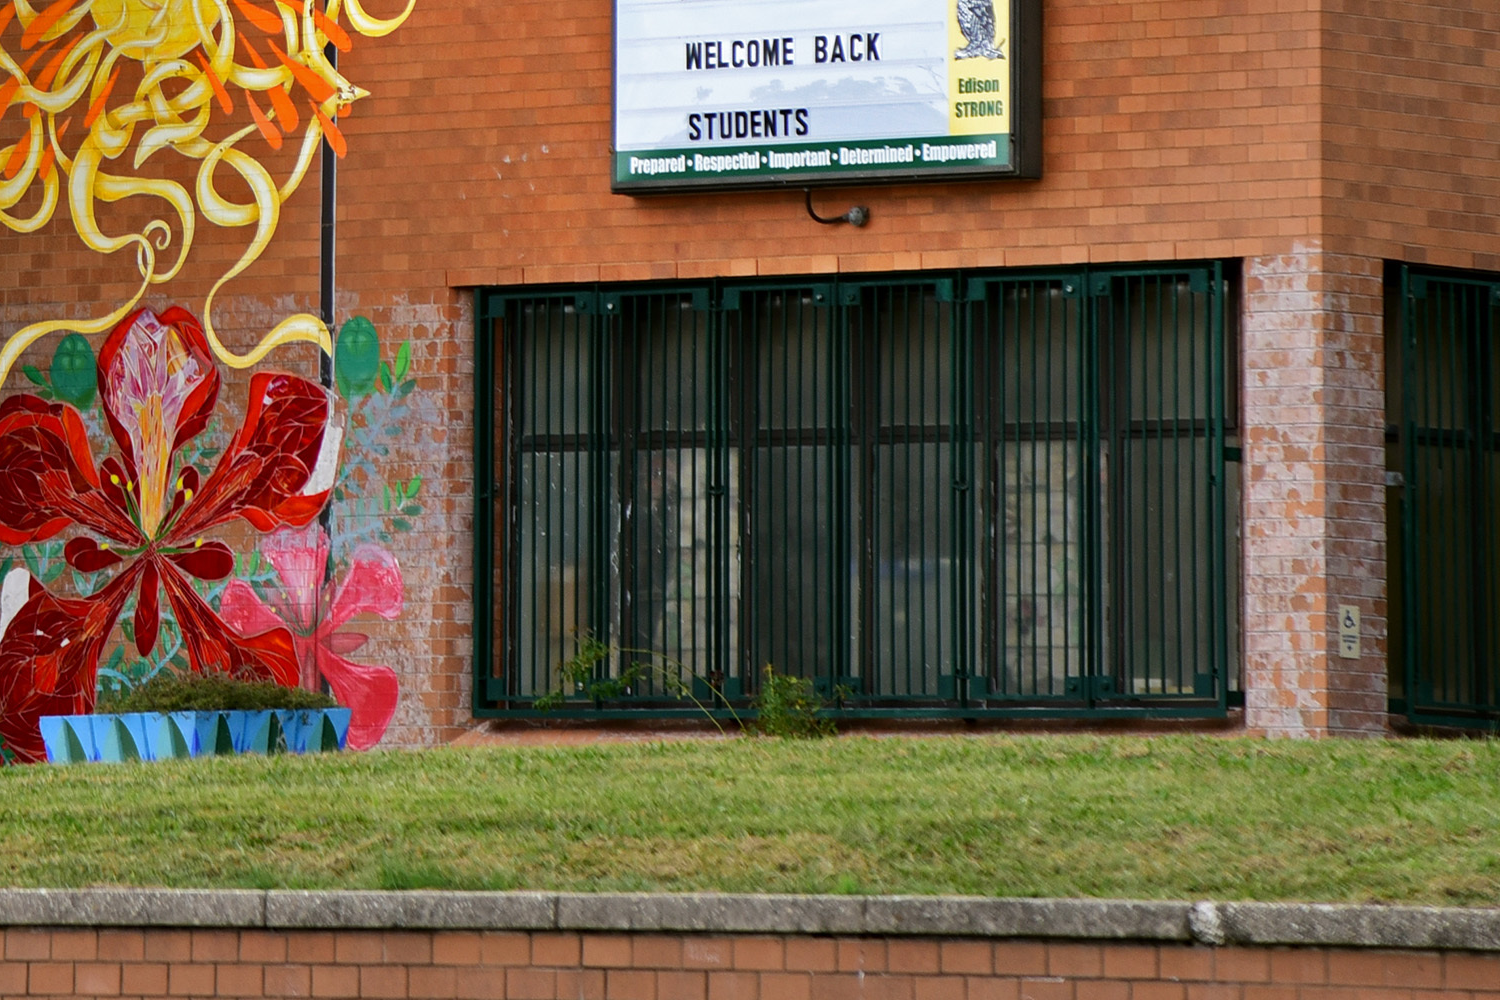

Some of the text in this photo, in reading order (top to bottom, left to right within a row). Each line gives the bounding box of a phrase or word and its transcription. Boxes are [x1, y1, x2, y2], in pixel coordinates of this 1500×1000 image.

[685, 33, 881, 70] WELCOME BACK
[958, 77, 1000, 96] Edison
[688, 108, 810, 141] STUDENTS
[955, 101, 1004, 119] STRONG
[630, 140, 997, 175] Prepared Respectful Important Determined Empowered
